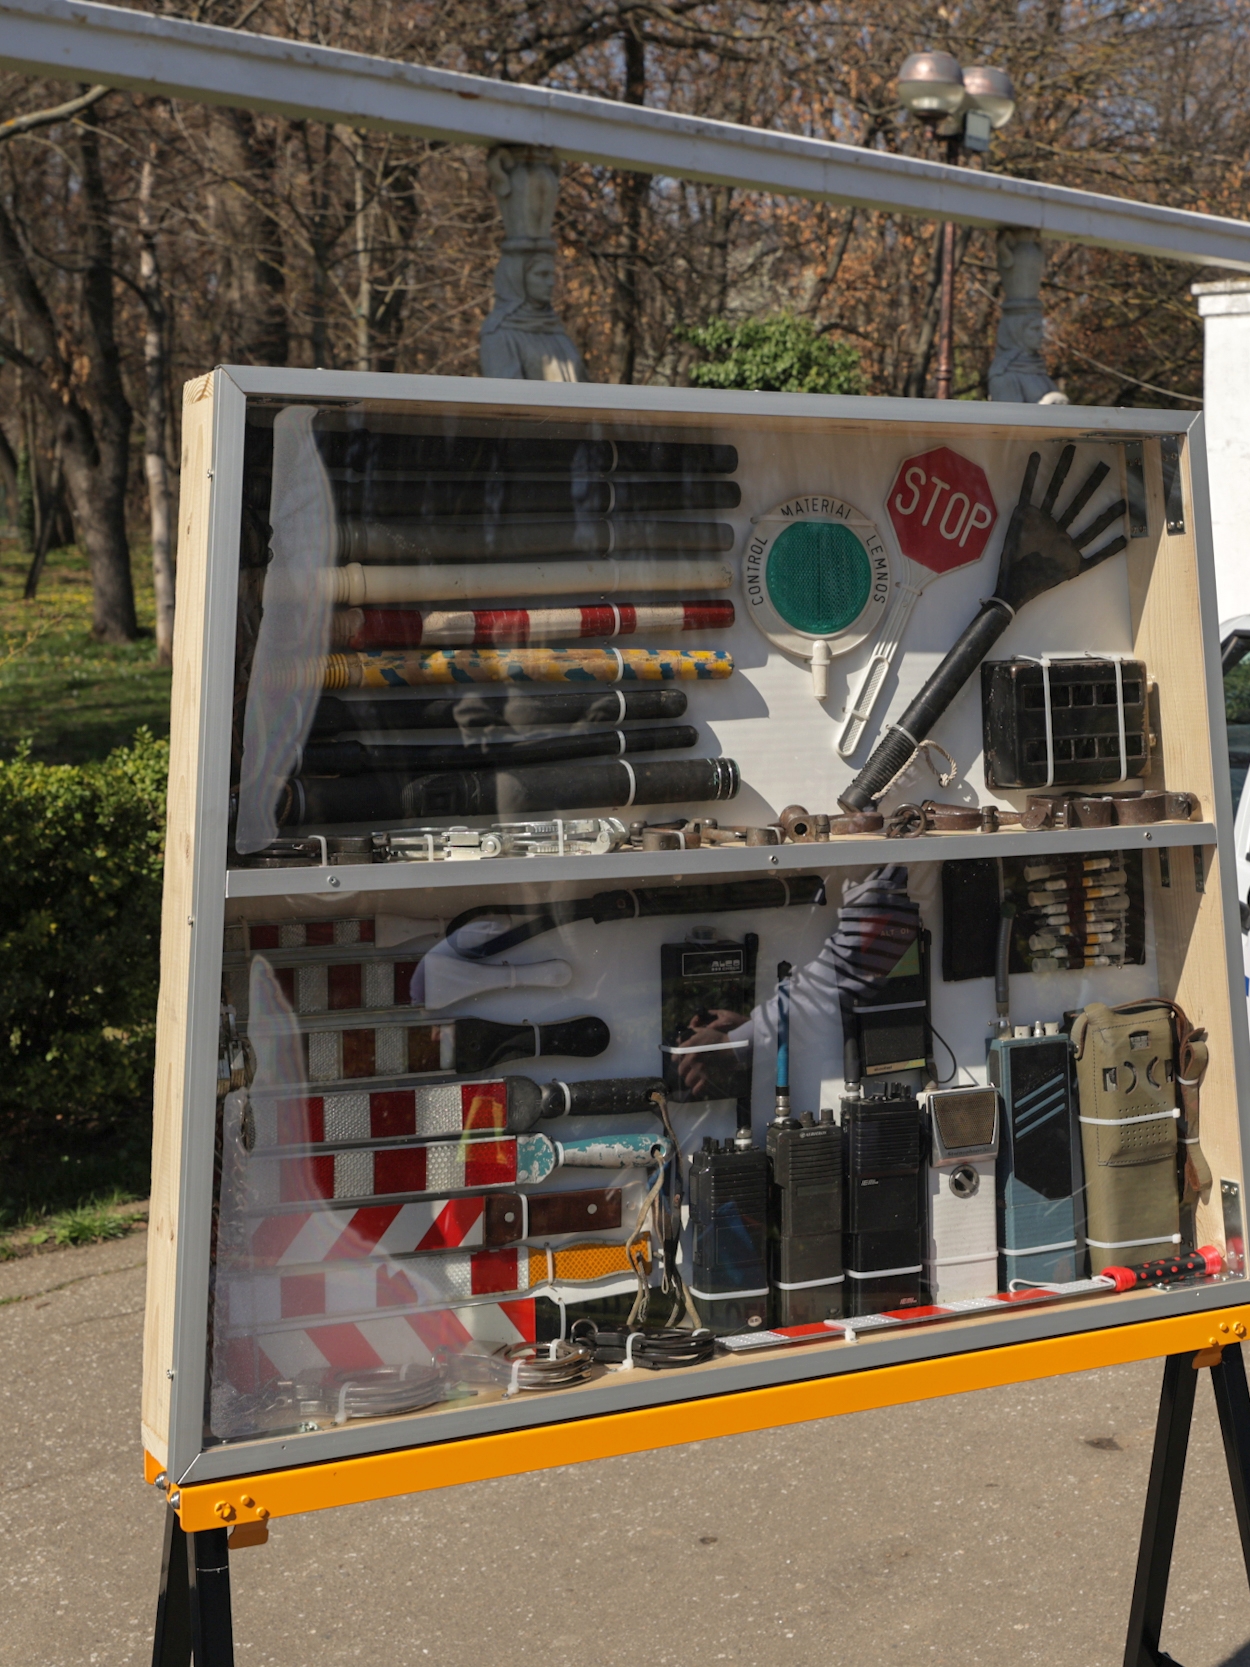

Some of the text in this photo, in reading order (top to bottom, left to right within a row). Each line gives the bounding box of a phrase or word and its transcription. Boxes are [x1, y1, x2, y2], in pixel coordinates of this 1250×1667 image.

[895, 466, 992, 548] STOP
[747, 537, 768, 606] CONTROL
[866, 534, 889, 604] LEMNOS
